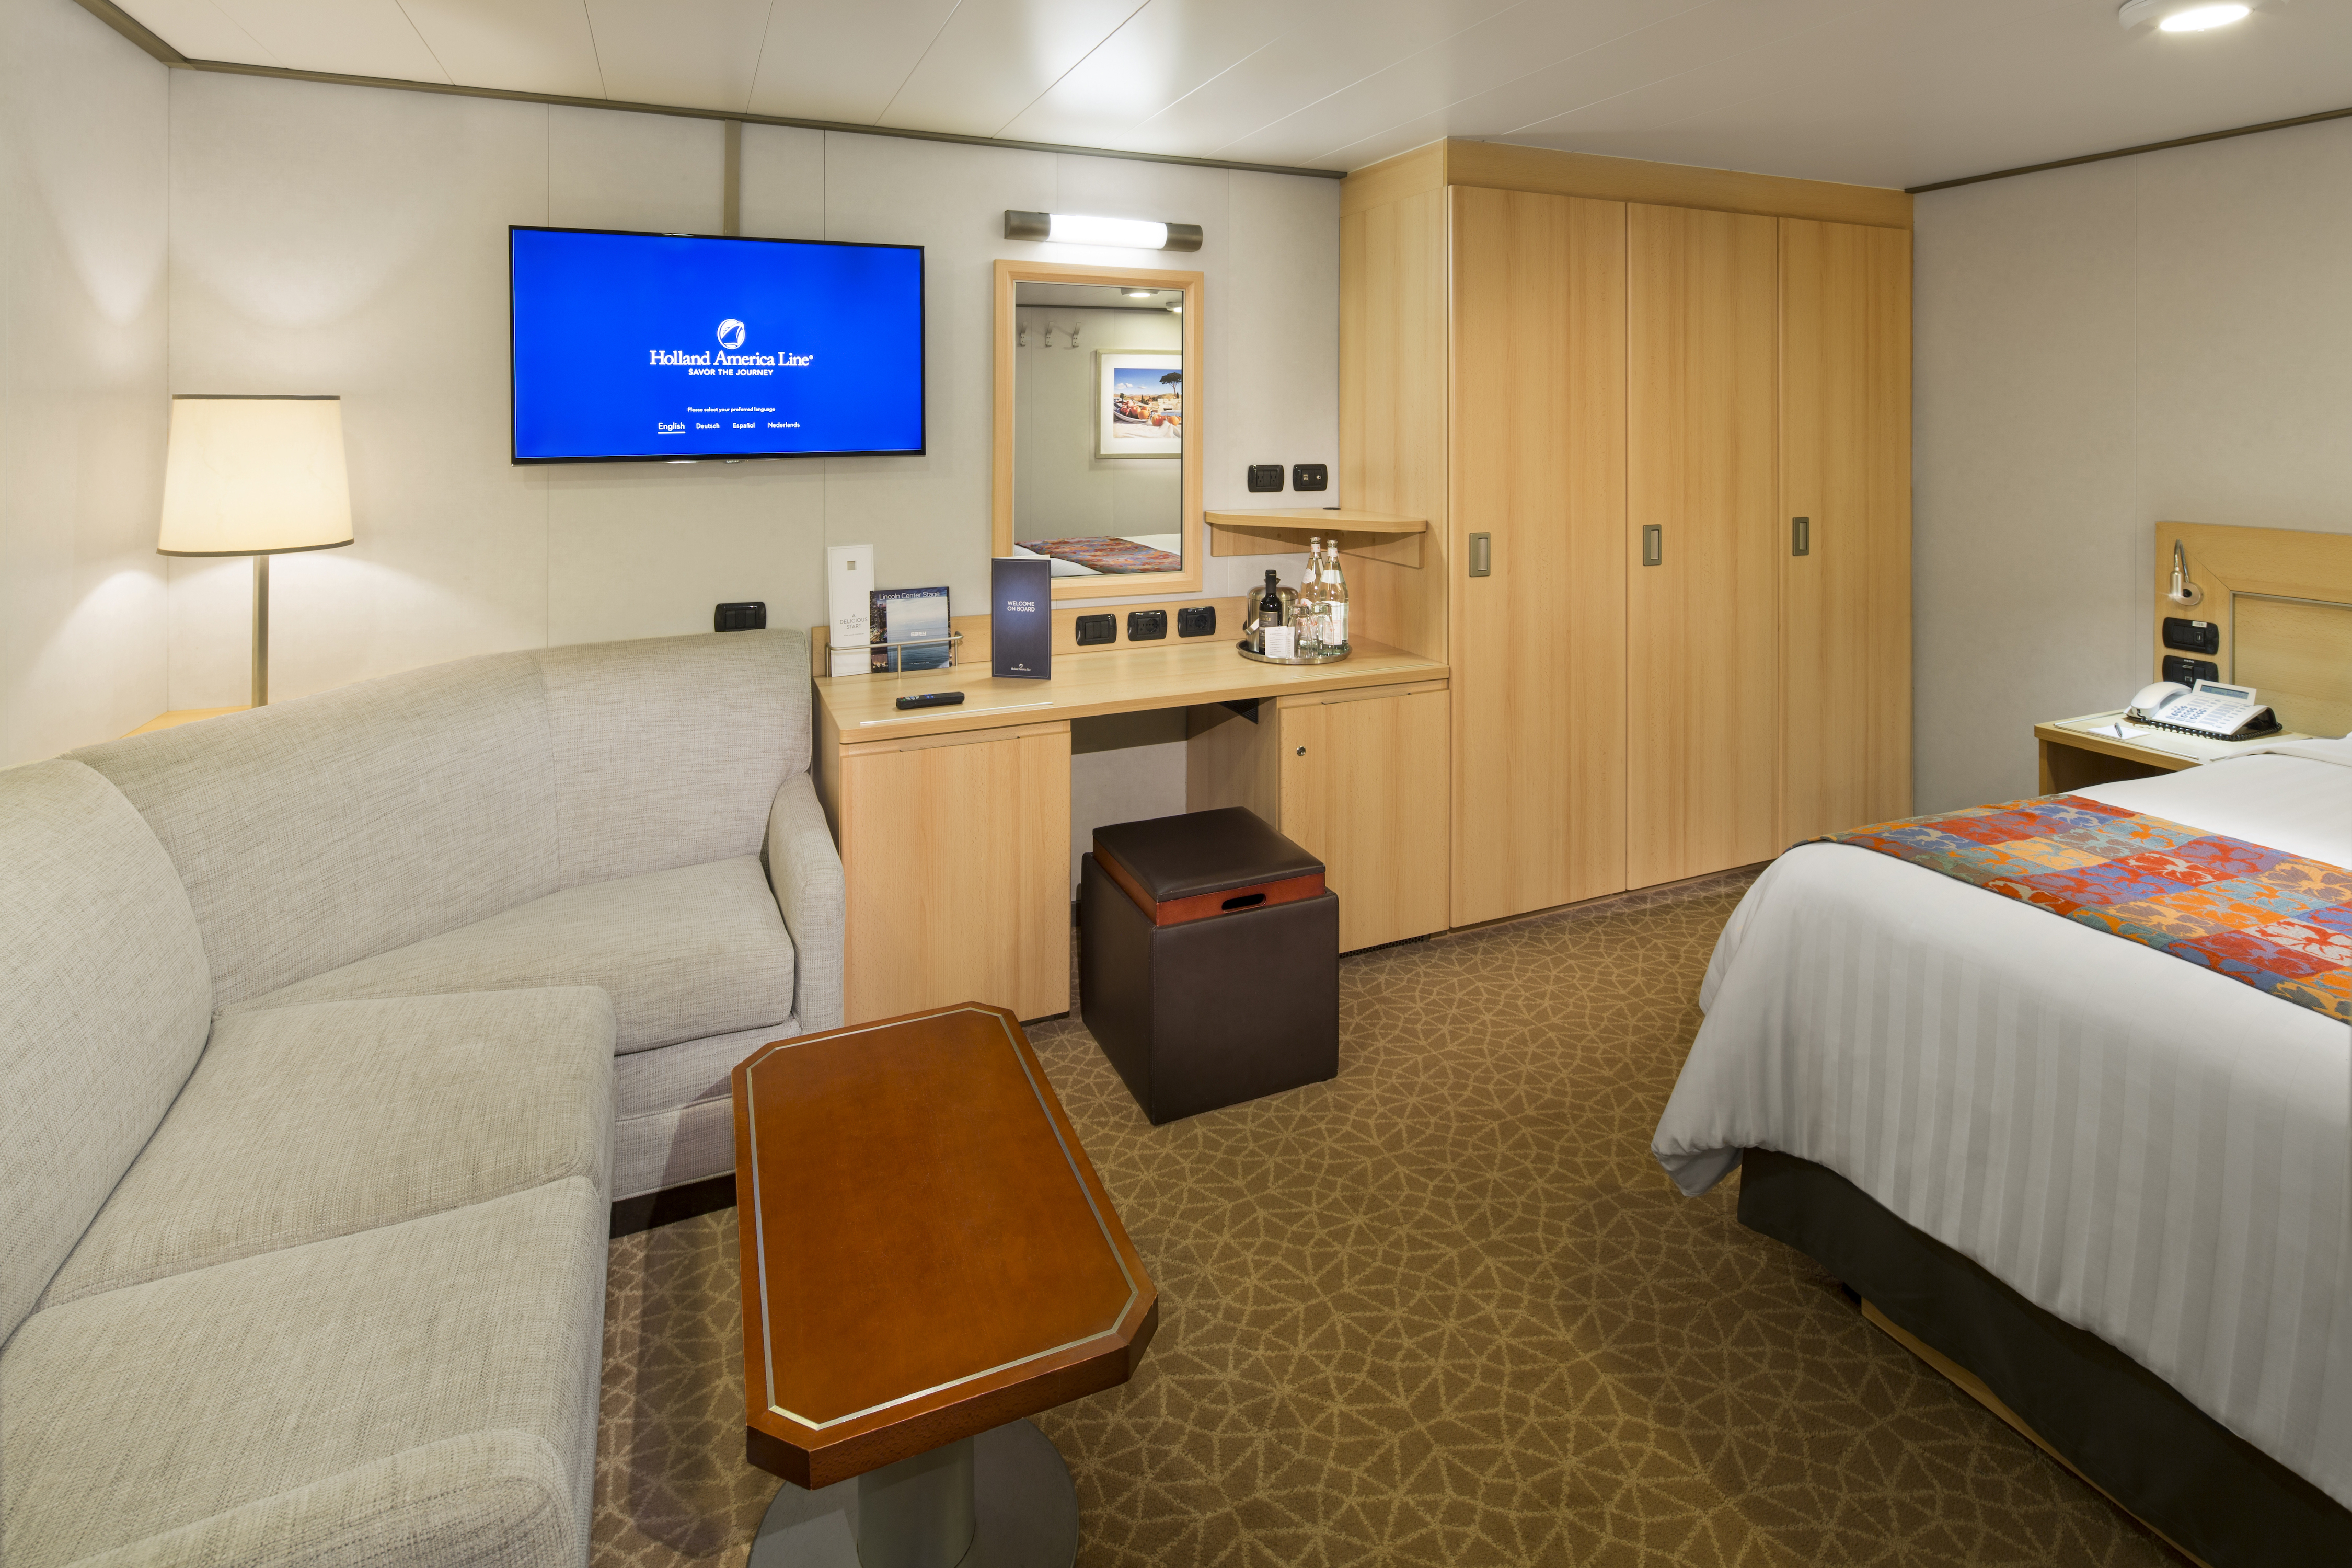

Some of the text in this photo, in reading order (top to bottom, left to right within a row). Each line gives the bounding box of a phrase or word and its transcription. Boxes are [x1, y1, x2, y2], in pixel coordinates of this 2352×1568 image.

[649, 350, 711, 365] Holland
[713, 350, 775, 366] America
[658, 422, 685, 431] English
